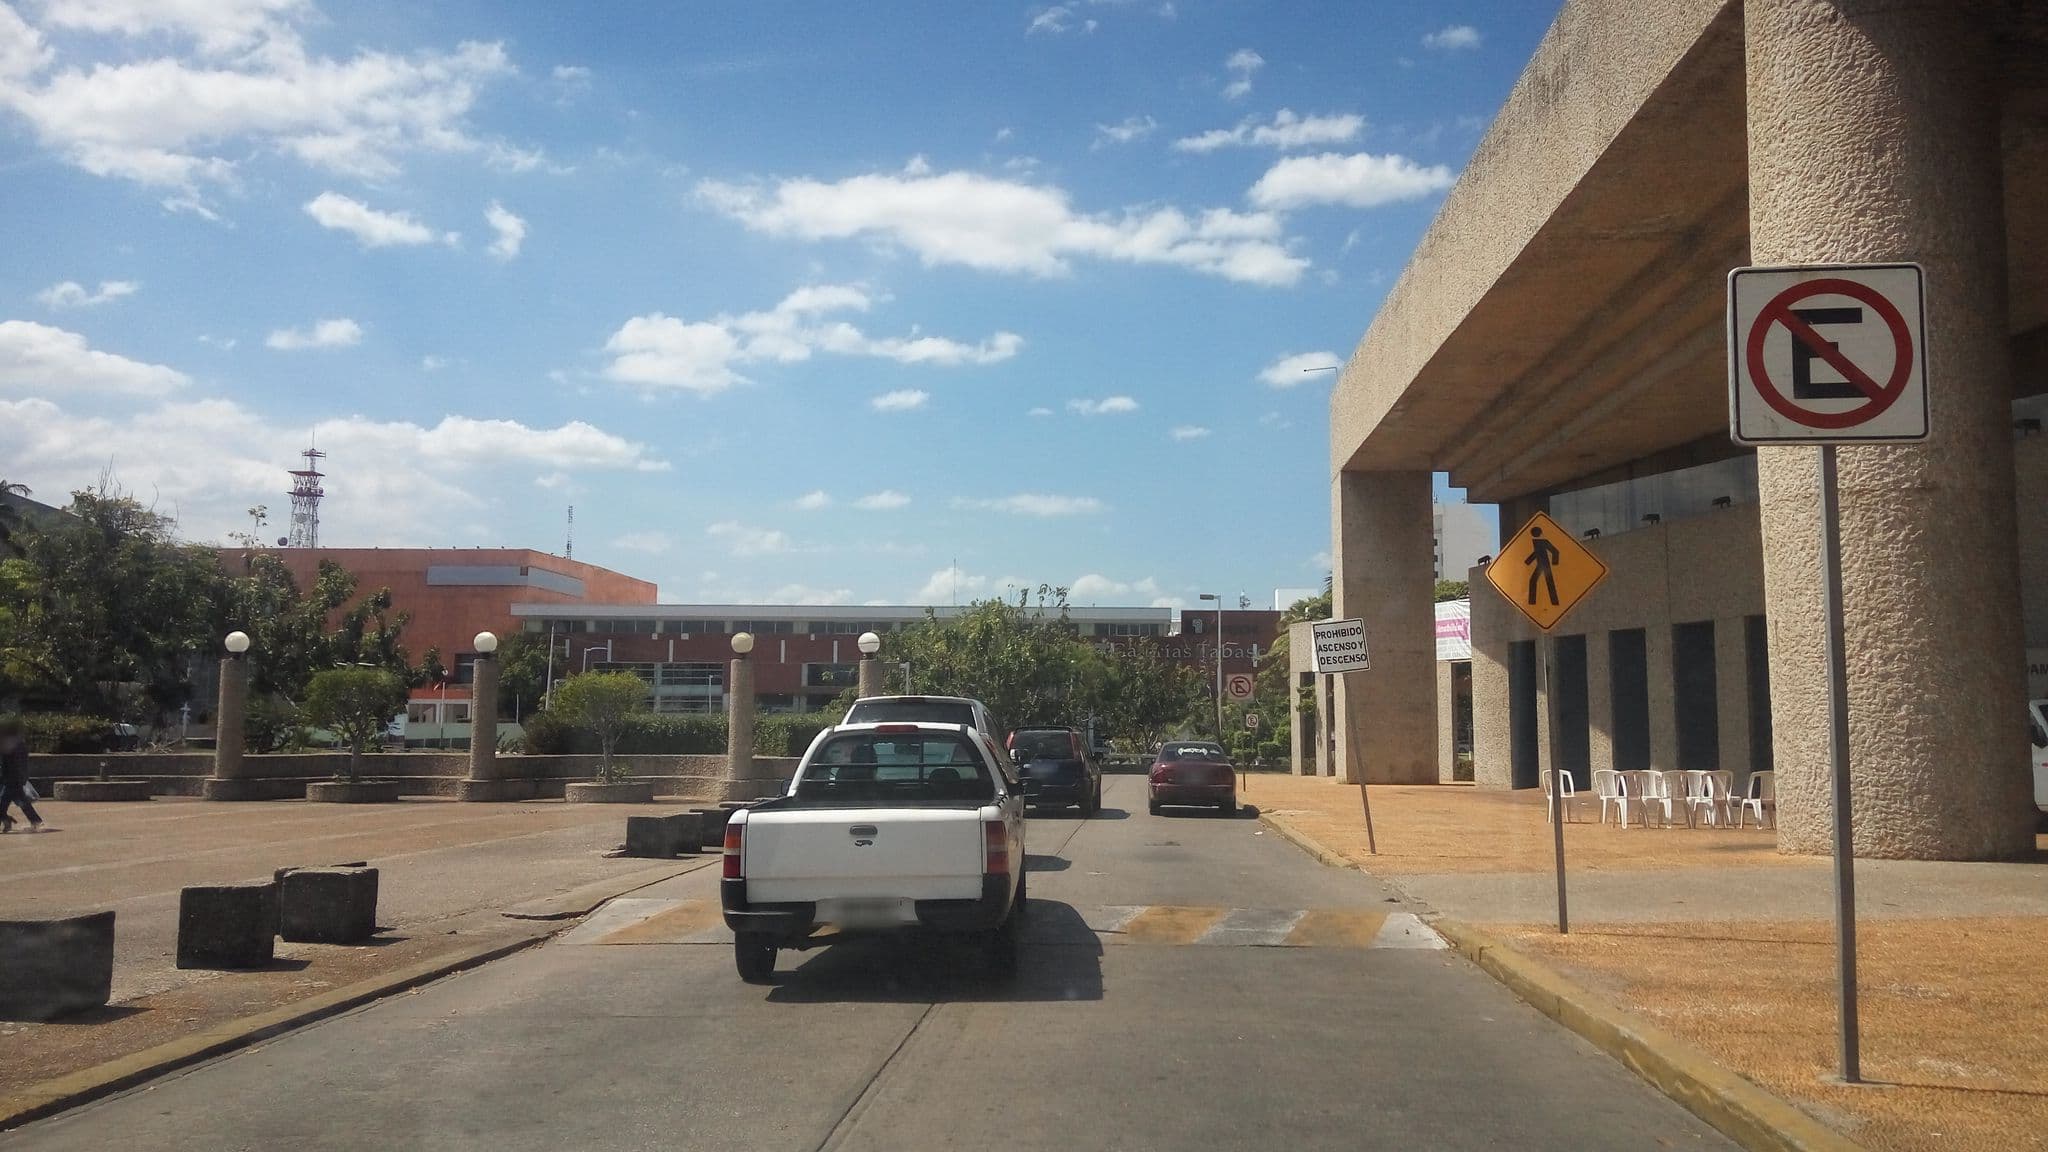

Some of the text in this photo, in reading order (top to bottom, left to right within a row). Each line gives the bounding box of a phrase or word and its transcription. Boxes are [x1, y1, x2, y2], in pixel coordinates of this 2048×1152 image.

[1791, 307, 1871, 399] E
[1315, 627, 1362, 640] PROHIBIDO
[1318, 641, 1364, 652] ASCENSO Y
[1320, 653, 1367, 665] DESCENSO
